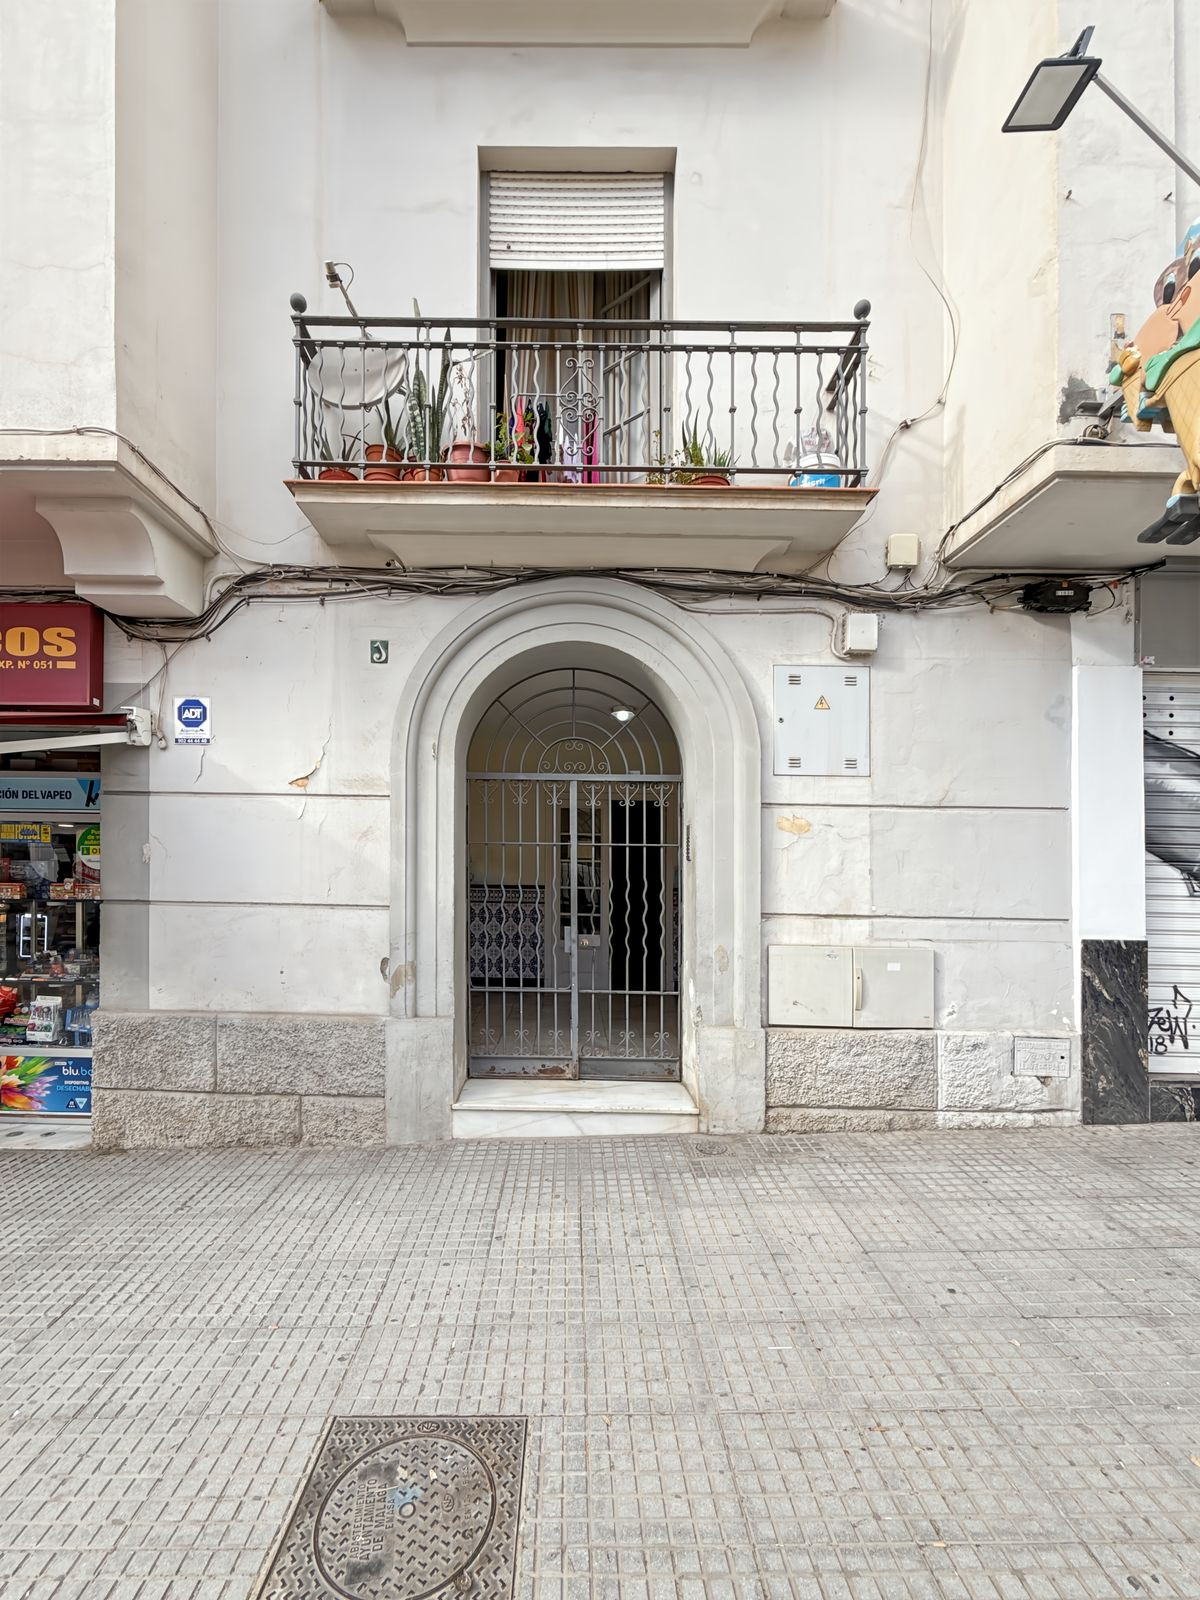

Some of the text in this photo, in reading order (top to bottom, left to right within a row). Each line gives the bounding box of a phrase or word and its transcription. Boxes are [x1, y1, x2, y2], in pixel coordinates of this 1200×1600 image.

[0, 627, 77, 657] OS
[33, 660, 53, 669] 051
[182, 708, 203, 719] ADT
[22, 790, 40, 799] DEL
[40, 790, 72, 800] VAPEO
[358, 1478, 379, 1561] AYUNTAMIENTO
[371, 1535, 384, 1552] DE
